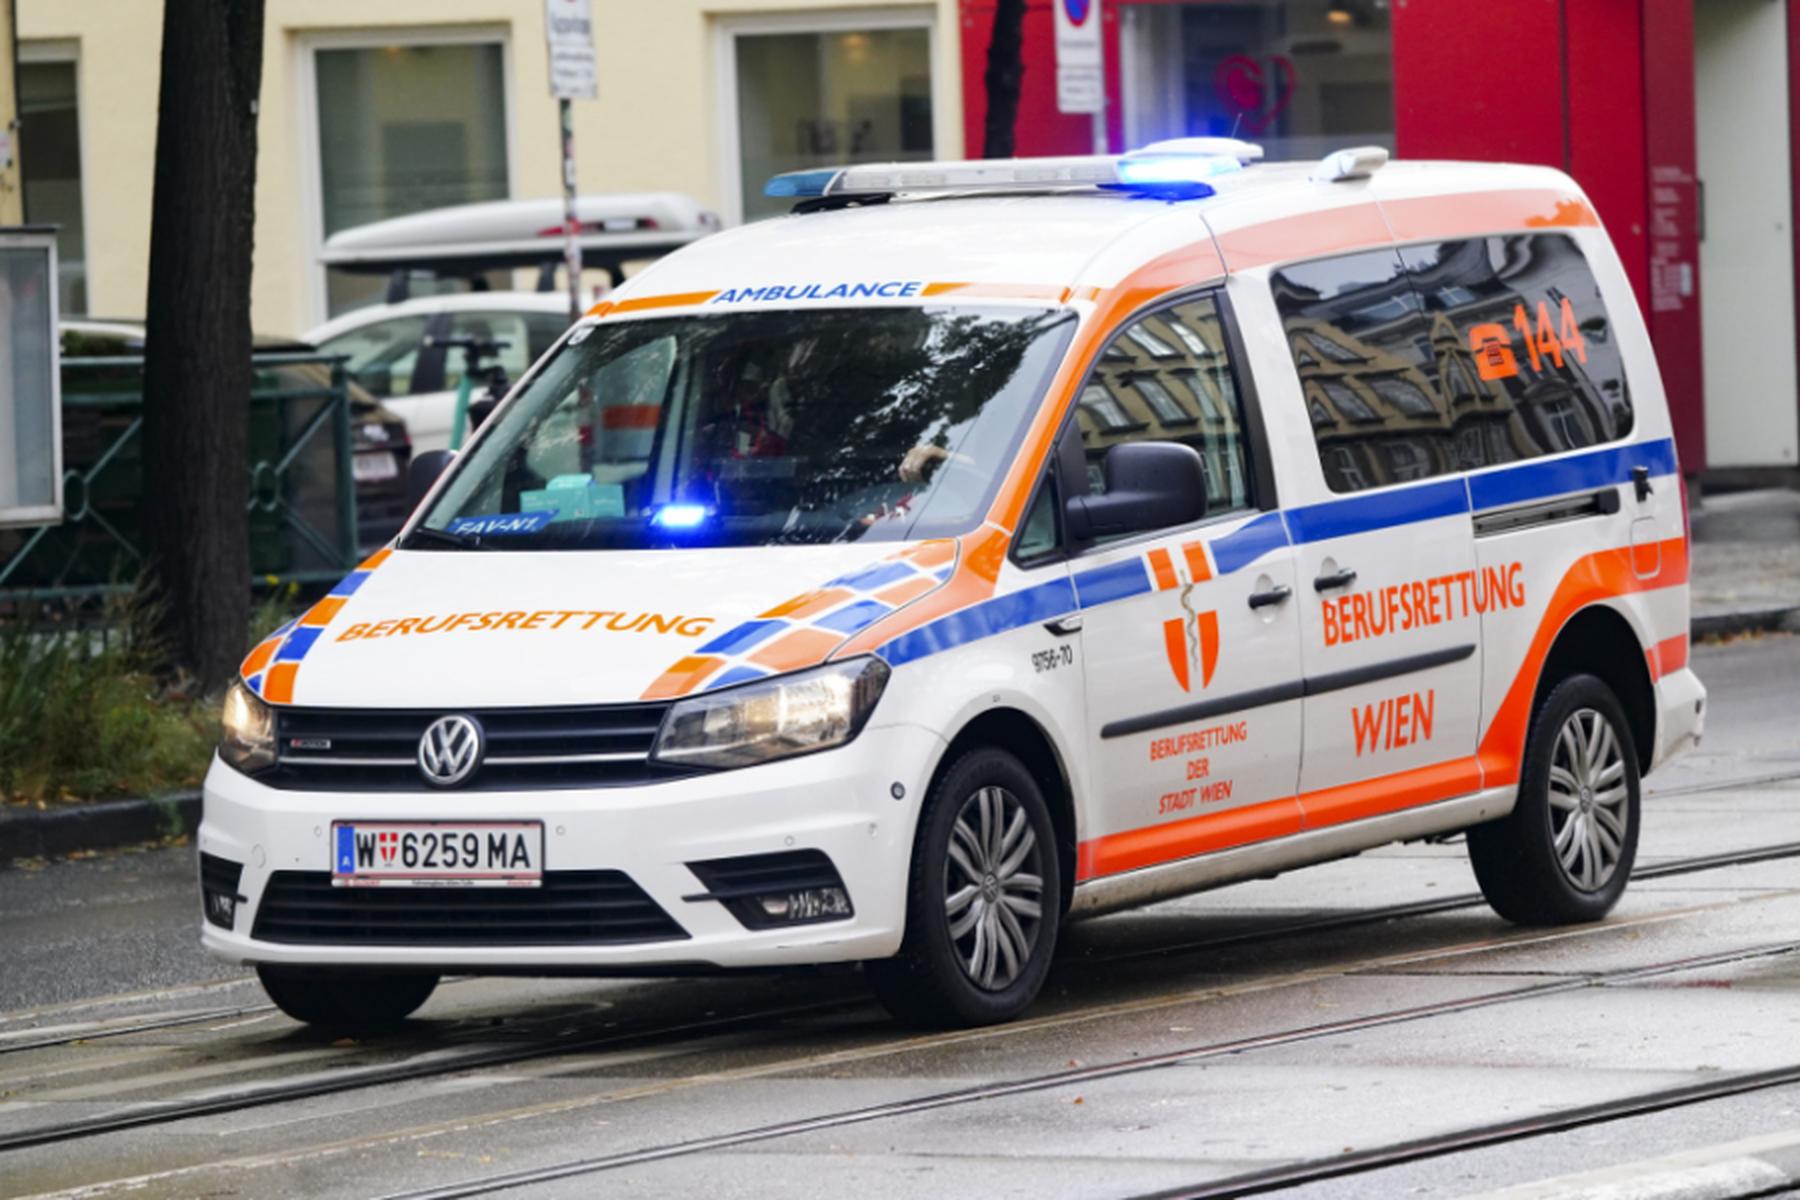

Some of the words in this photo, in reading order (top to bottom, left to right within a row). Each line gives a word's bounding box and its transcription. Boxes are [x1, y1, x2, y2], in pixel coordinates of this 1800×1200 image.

[712, 281, 922, 304] AMBULANCE
[1513, 297, 1588, 373] 144
[1322, 561, 1526, 647] BERUFSRETTUNG
[335, 610, 715, 642] BERUFSRETTUNG
[1150, 720, 1248, 762] BERUFSRETTUNG
[1351, 689, 1435, 758] WIEN
[1186, 758, 1209, 781] DER
[1158, 787, 1197, 815] STADT
[1199, 779, 1233, 803] WIEN
[355, 832, 377, 868] W
[401, 832, 480, 868] 6259
[486, 832, 531, 869] MA
